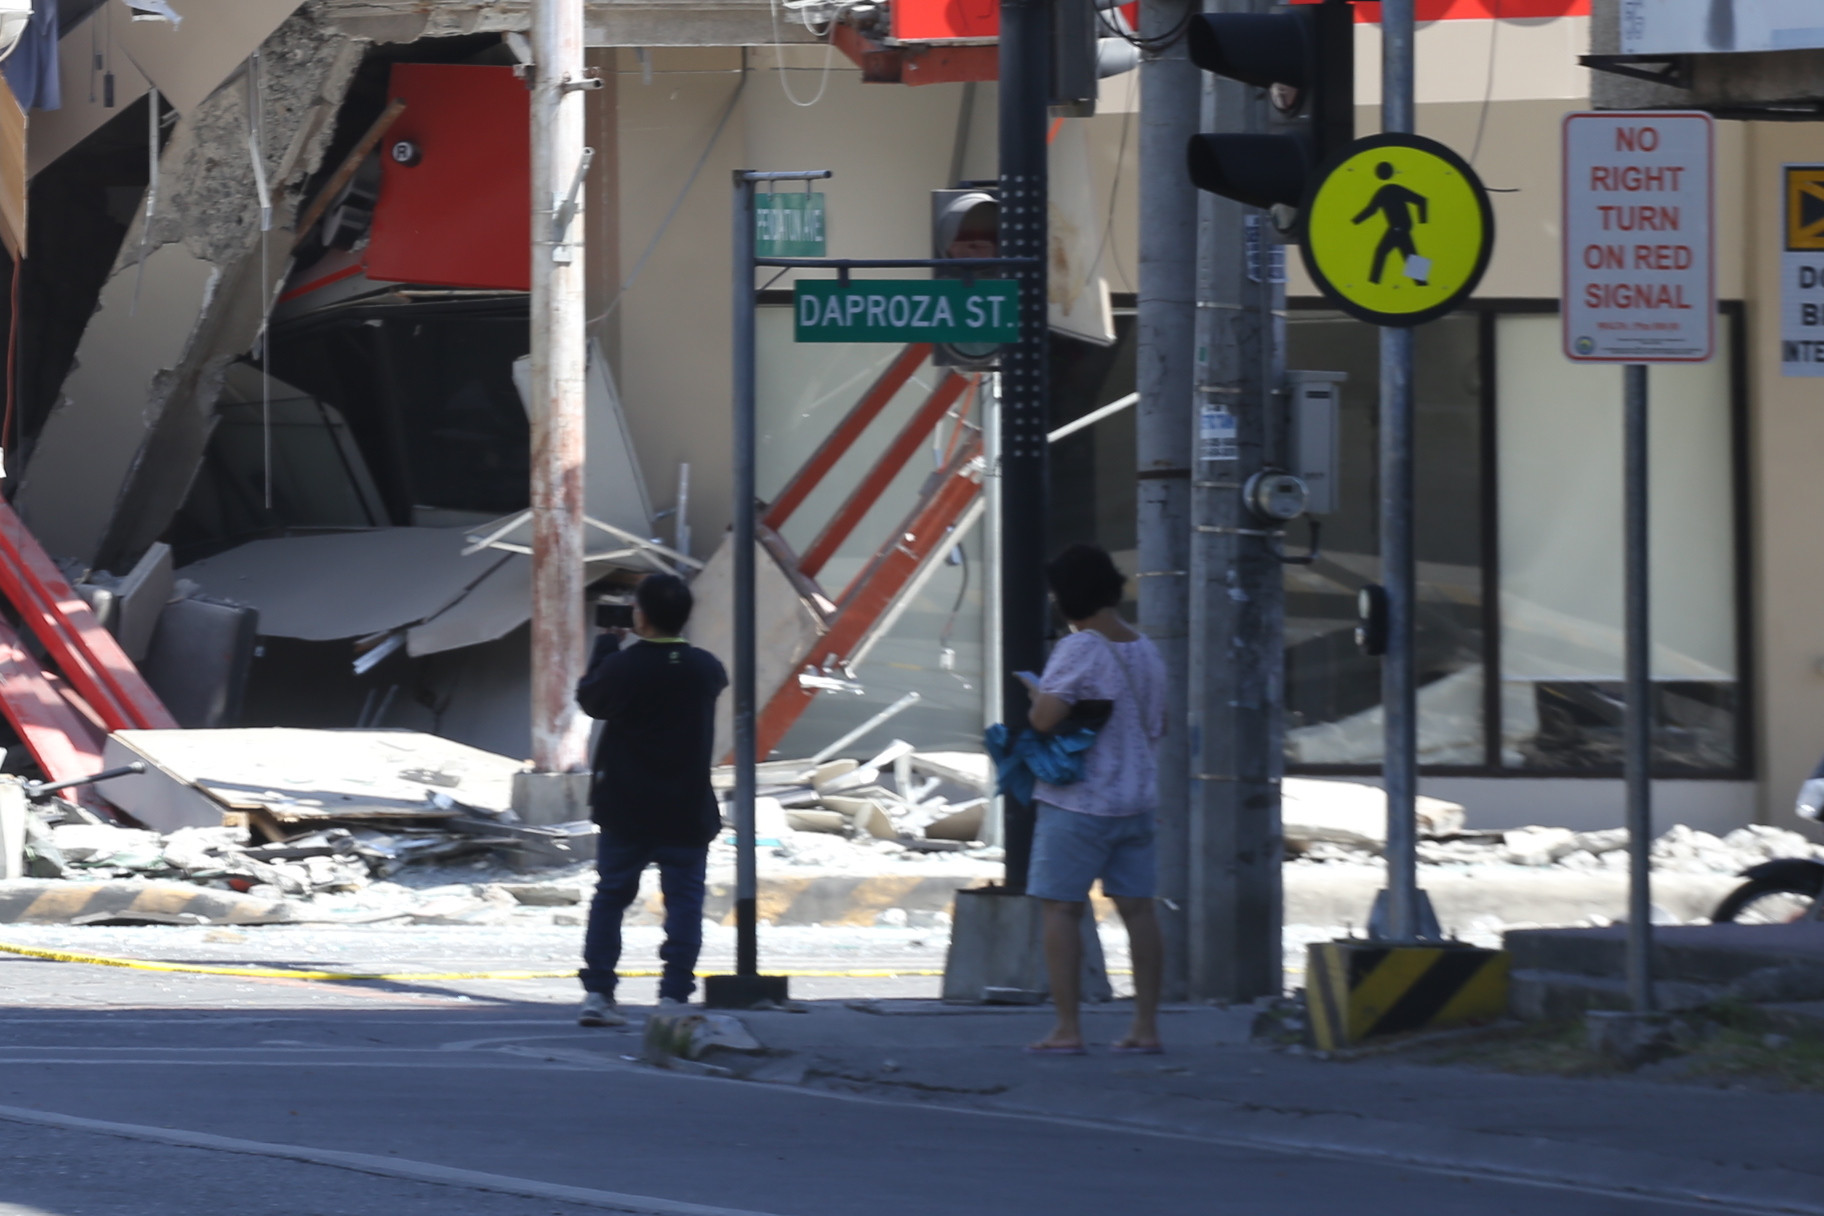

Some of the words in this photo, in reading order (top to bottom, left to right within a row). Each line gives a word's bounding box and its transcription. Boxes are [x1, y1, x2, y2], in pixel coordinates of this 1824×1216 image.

[1615, 127, 1659, 152] NO
[1590, 166, 1684, 192] RIGHT
[1597, 206, 1680, 231] TURN
[1583, 245, 1625, 270] ON
[1635, 245, 1692, 270] RED
[1585, 284, 1692, 309] SIGNAL
[799, 295, 954, 328] DAPROZA
[965, 295, 1014, 328] ST.
